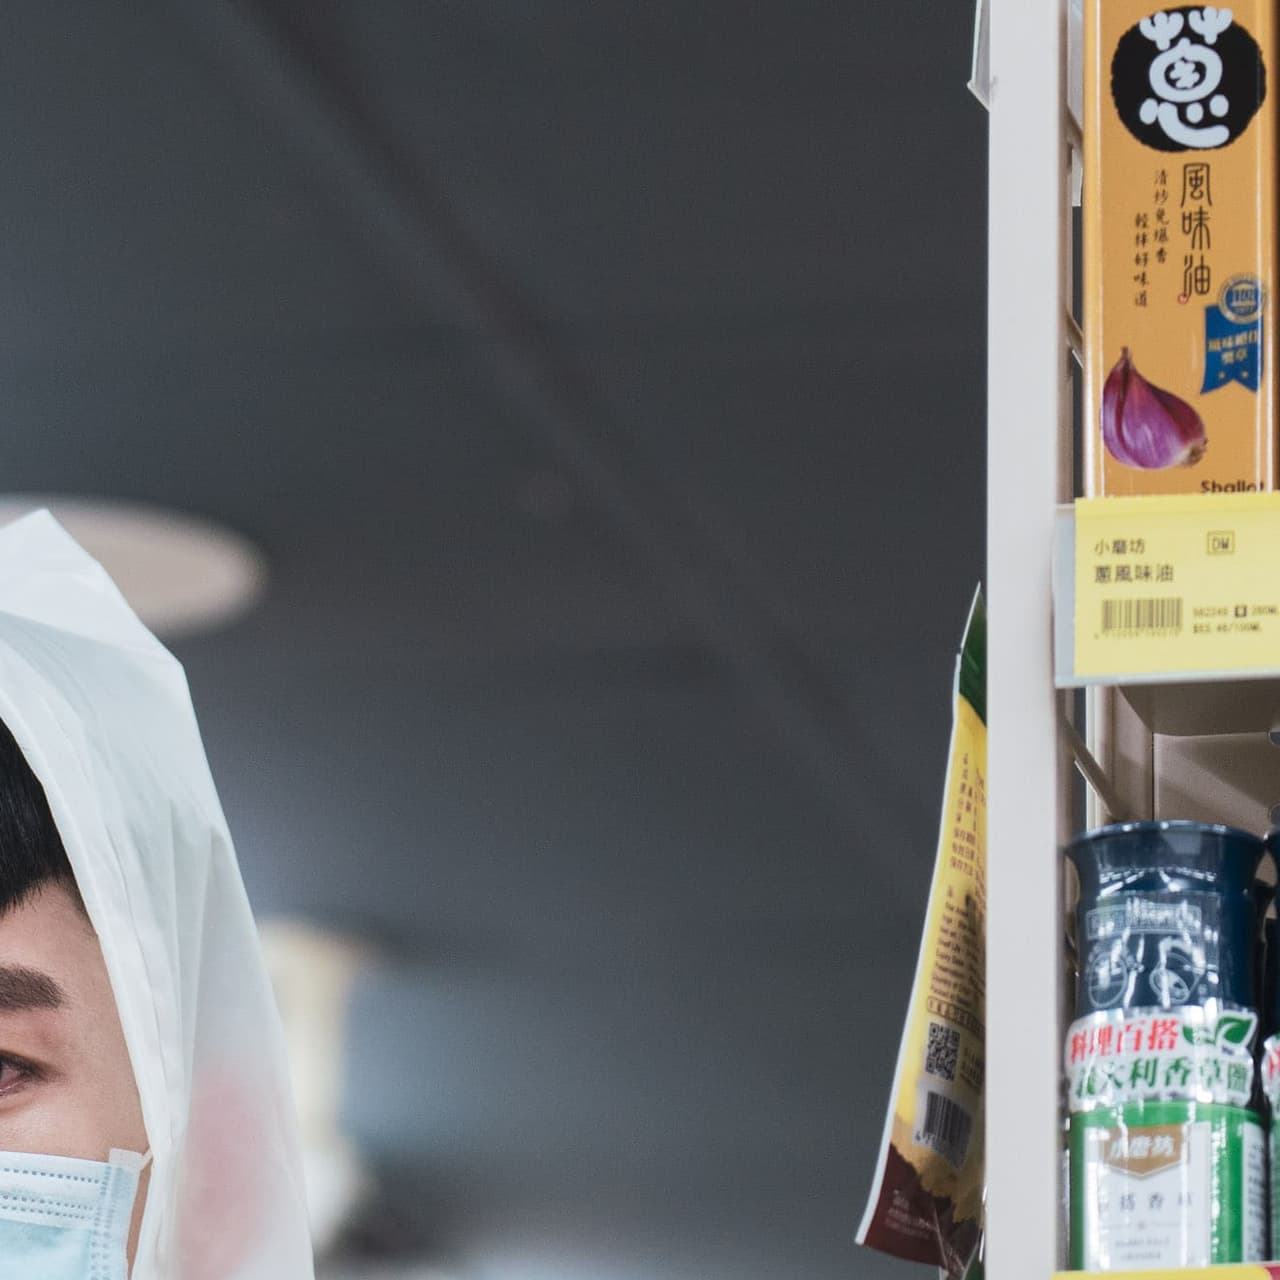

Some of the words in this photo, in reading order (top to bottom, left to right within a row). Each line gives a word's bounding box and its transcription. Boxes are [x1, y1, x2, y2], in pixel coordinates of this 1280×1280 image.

[1181, 163, 1213, 297] 風味油
[1094, 538, 1145, 555] 小磨坊
[1070, 1018, 1179, 1065] 料理百搭
